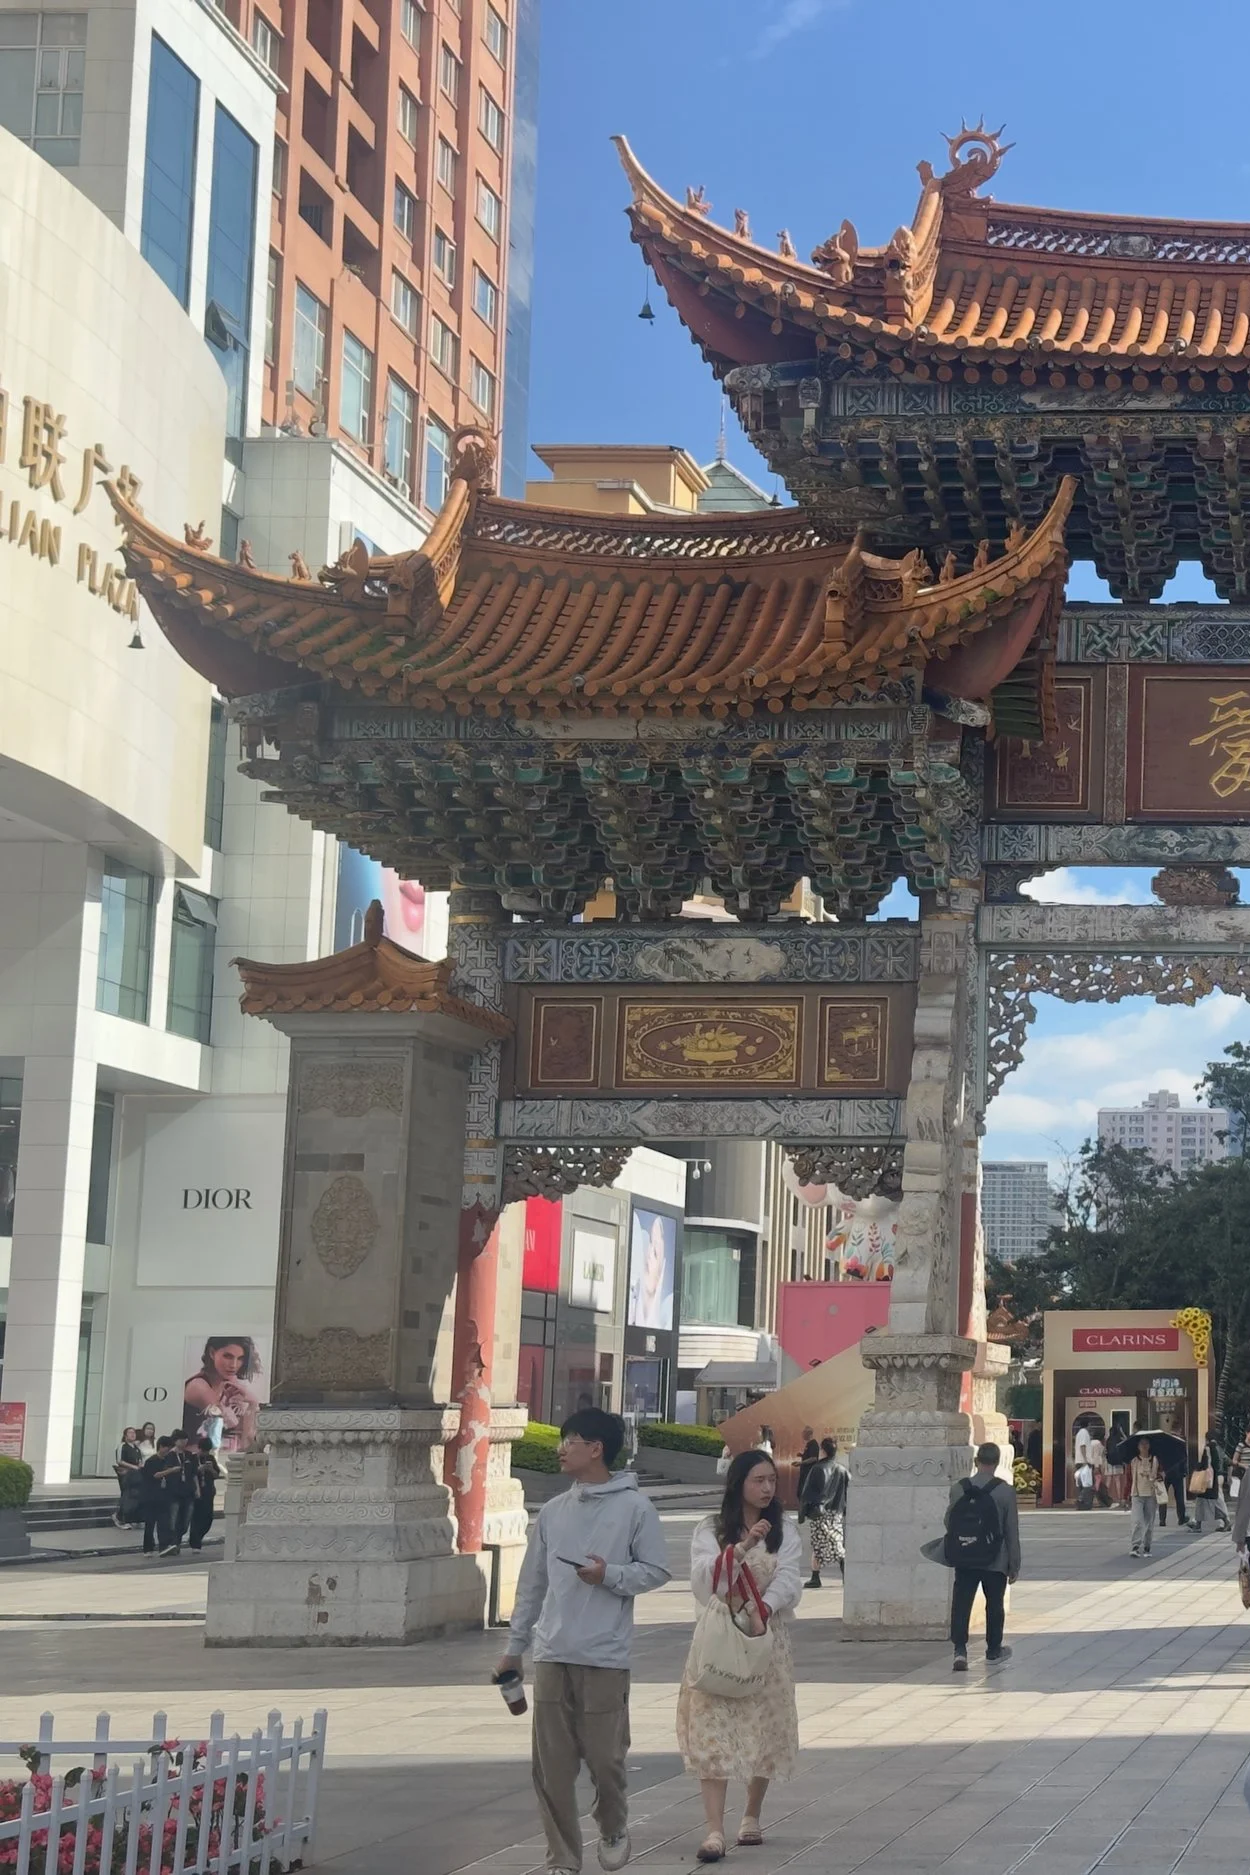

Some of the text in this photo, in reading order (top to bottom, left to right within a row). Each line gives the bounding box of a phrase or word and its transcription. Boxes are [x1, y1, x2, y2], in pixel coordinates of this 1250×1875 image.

[77, 542, 138, 623] PLAZA
[181, 1187, 253, 1210] DIOR
[1086, 1334, 1166, 1346] CLARINS
[1079, 1387, 1122, 1395] CLARINS
